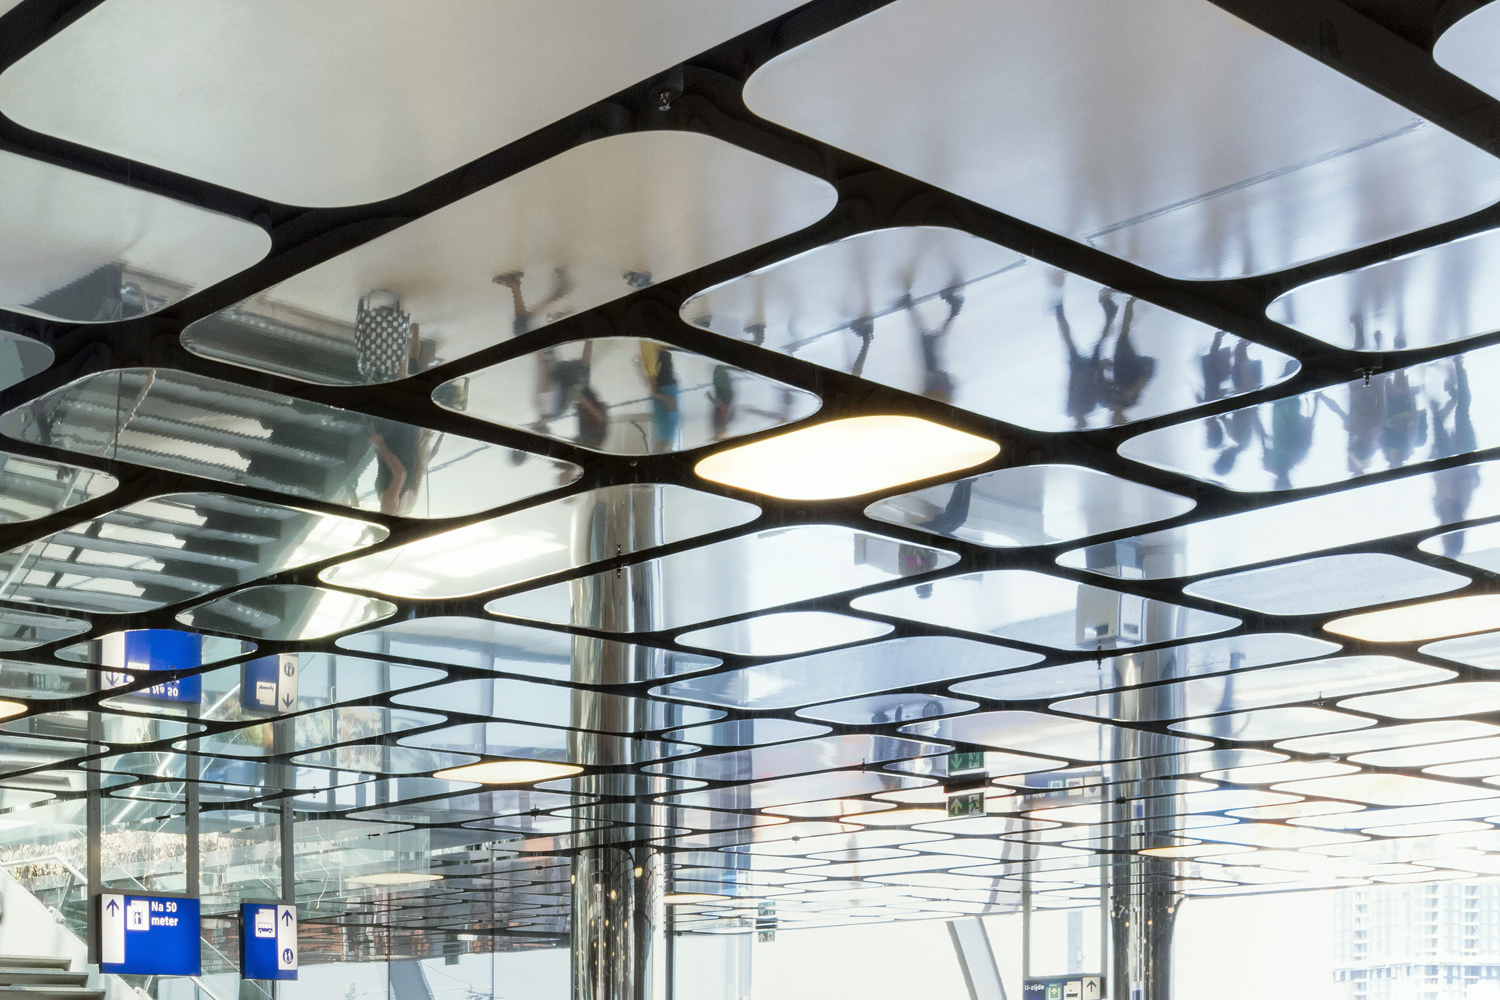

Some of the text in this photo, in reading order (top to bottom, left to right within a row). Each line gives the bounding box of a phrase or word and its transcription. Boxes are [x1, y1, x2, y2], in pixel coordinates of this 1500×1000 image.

[151, 901, 177, 913] Na 50
[151, 916, 179, 927] meter
